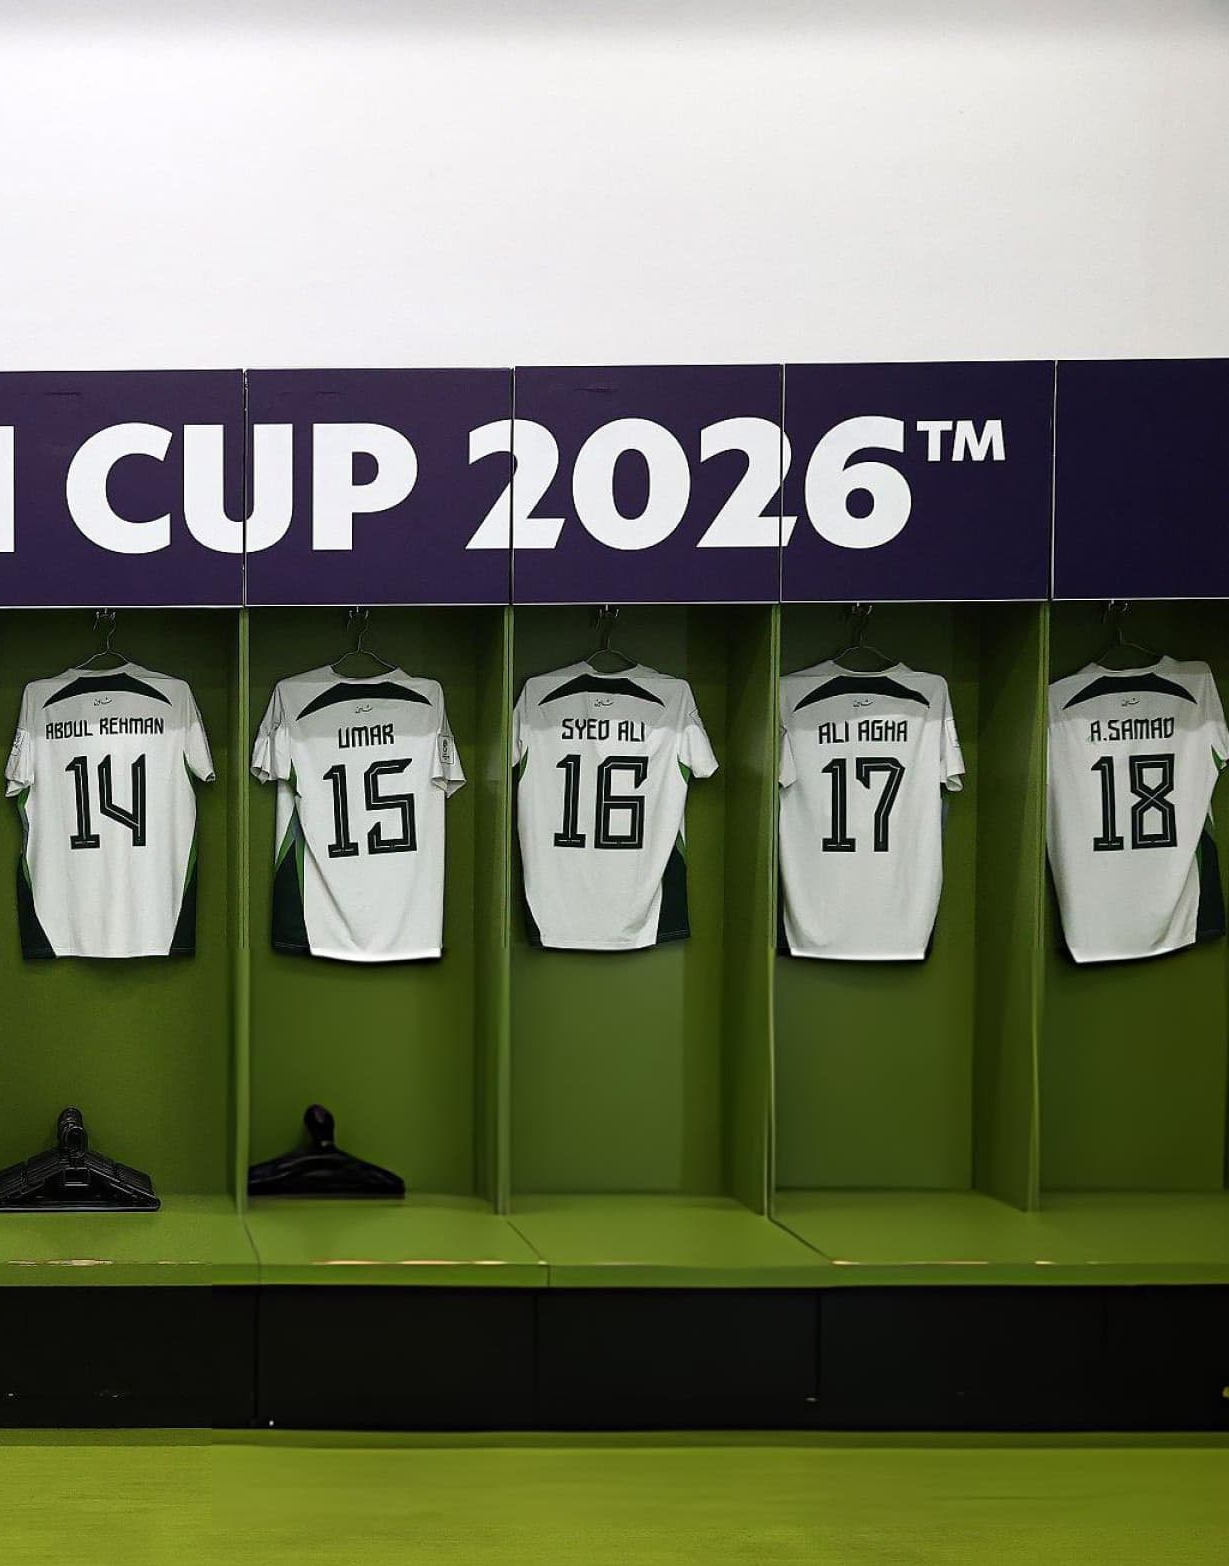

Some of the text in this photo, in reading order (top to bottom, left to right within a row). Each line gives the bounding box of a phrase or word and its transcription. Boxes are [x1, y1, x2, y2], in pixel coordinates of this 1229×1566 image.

[66, 422, 418, 554] CUP
[45, 716, 164, 740] ABDUL REHMAN
[337, 723, 395, 749] UMAR
[561, 718, 645, 743] SYED ALI
[818, 719, 908, 745] ALI AGHA
[1090, 716, 1175, 743] A.SAMAD
[64, 753, 147, 850] 14
[322, 757, 418, 859] 15
[553, 753, 649, 850] 16
[821, 756, 906, 853] 17
[1090, 752, 1178, 852] 18
